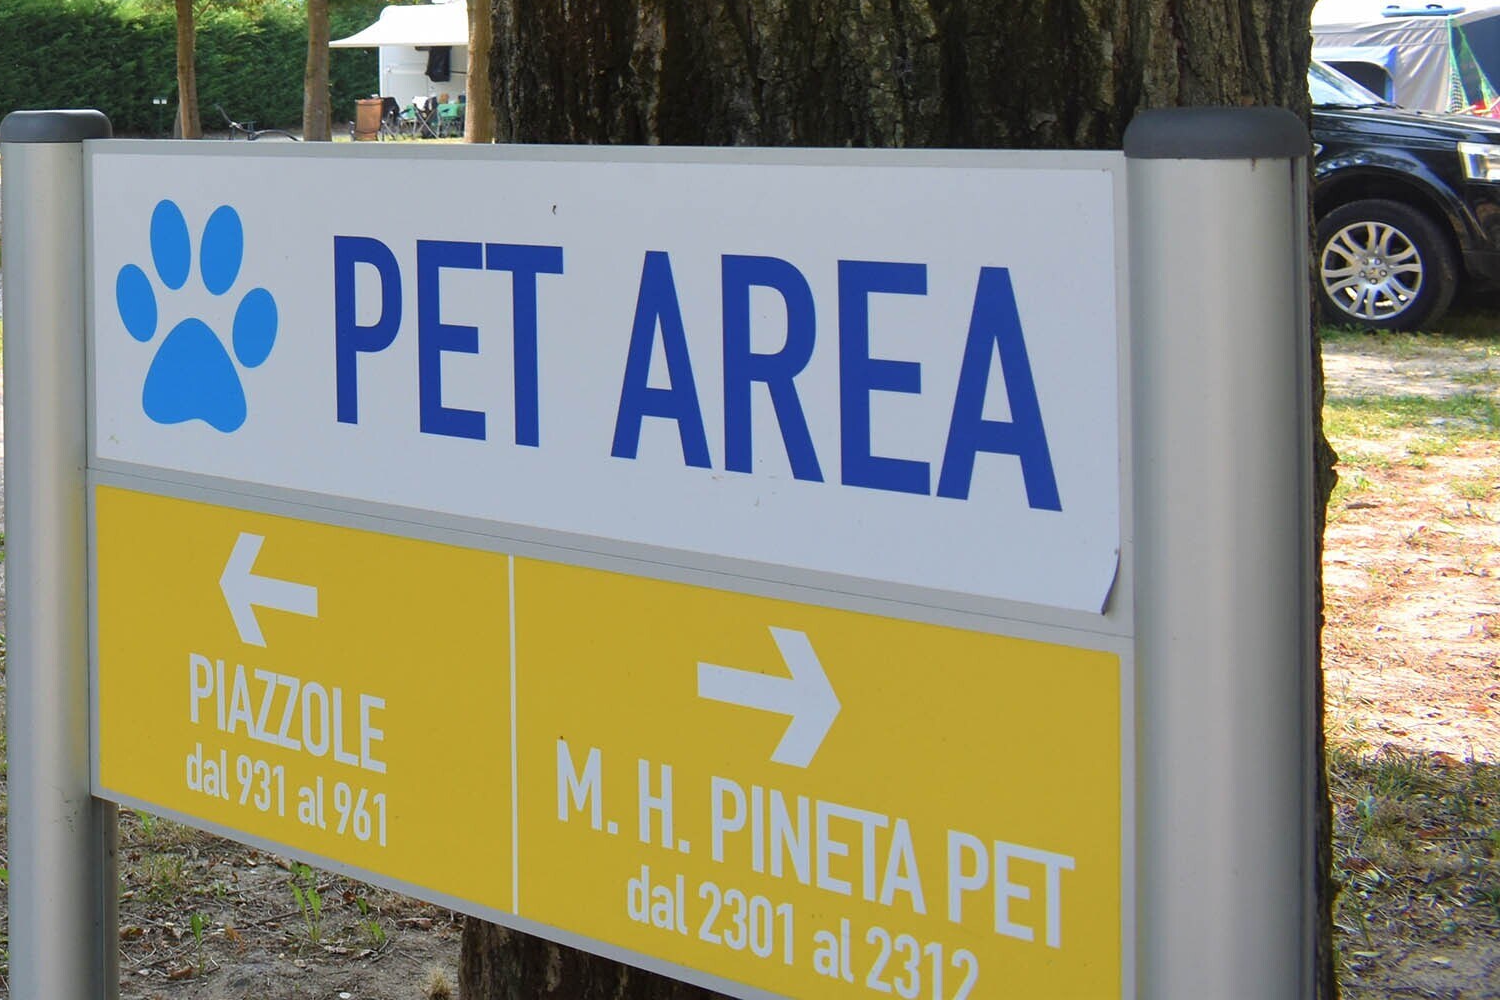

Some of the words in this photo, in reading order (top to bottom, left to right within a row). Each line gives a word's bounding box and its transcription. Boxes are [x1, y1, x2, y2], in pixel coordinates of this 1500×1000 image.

[334, 235, 564, 448] PET
[611, 250, 1062, 512] AREA
[189, 653, 387, 774] PIAZZOLE
[186, 743, 229, 801] dal
[237, 754, 285, 817] 931
[297, 776, 326, 831] al
[334, 782, 388, 847] 961
[556, 739, 619, 835] M.
[638, 758, 691, 854] H.
[711, 775, 927, 915] PINETA
[947, 829, 1076, 949] PET
[627, 864, 688, 936] dal
[698, 881, 794, 966] 2301
[813, 918, 855, 983] al
[866, 926, 979, 1000] 2312
